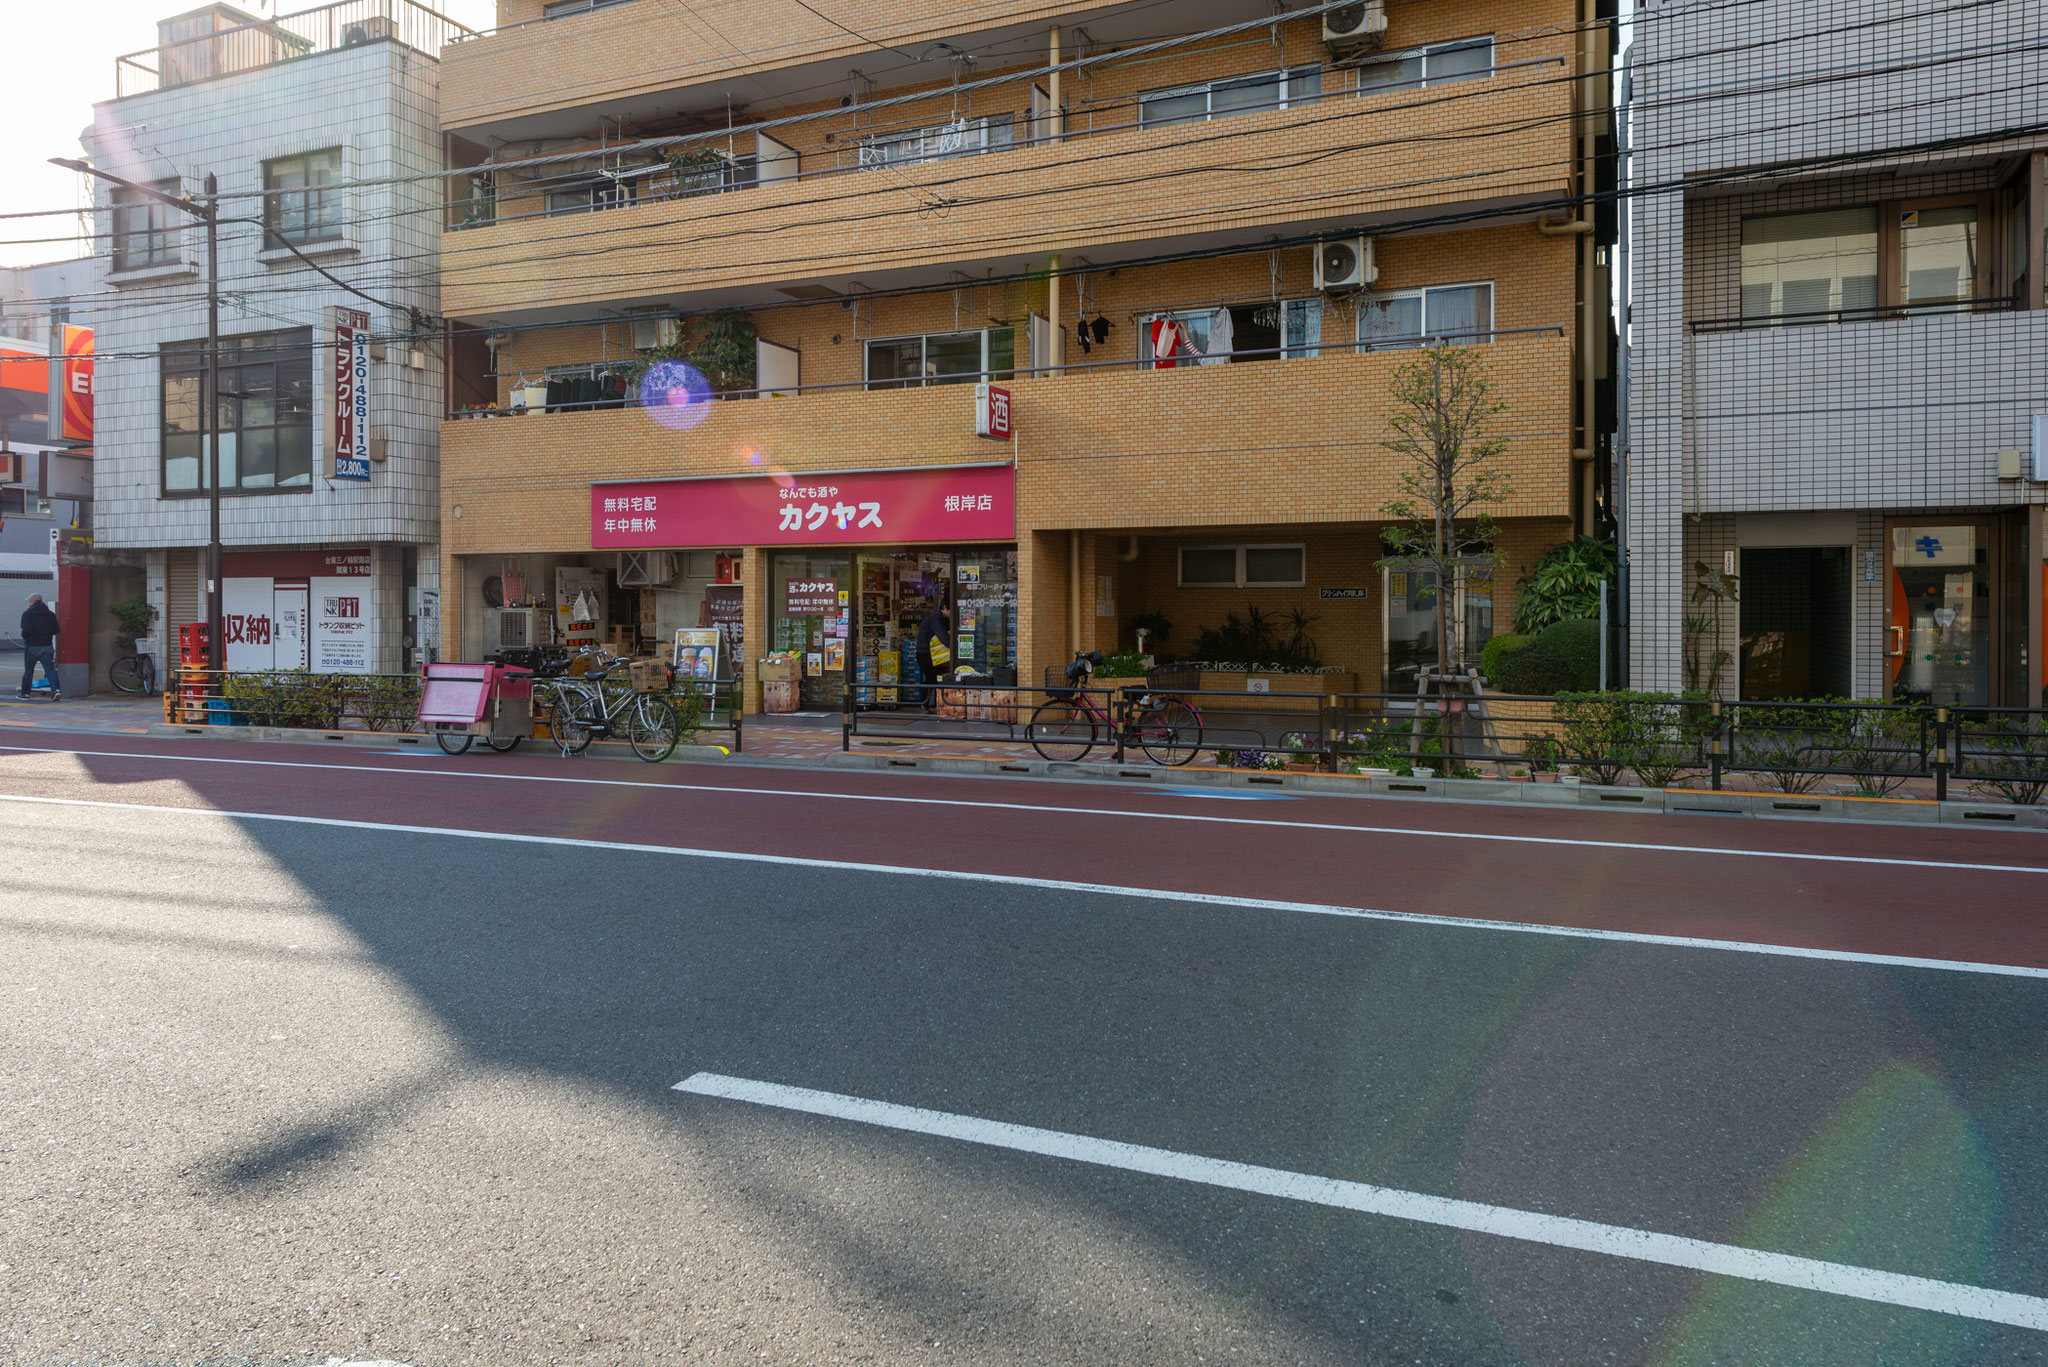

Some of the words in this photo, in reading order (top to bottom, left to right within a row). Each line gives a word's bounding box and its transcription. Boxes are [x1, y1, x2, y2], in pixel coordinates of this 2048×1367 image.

[71, 371, 94, 395] E
[337, 330, 351, 454] トランクルーム
[355, 333, 367, 456] 0120-488-112
[991, 392, 1009, 432] 酒
[779, 486, 838, 499] なんでも酒や
[604, 496, 657, 512] 無料宅配
[944, 494, 993, 512] 根岸店
[604, 517, 657, 533] 年中無休
[779, 501, 883, 531] カクヤス
[800, 582, 835, 593] カクヤス
[325, 608, 337, 616] NK
